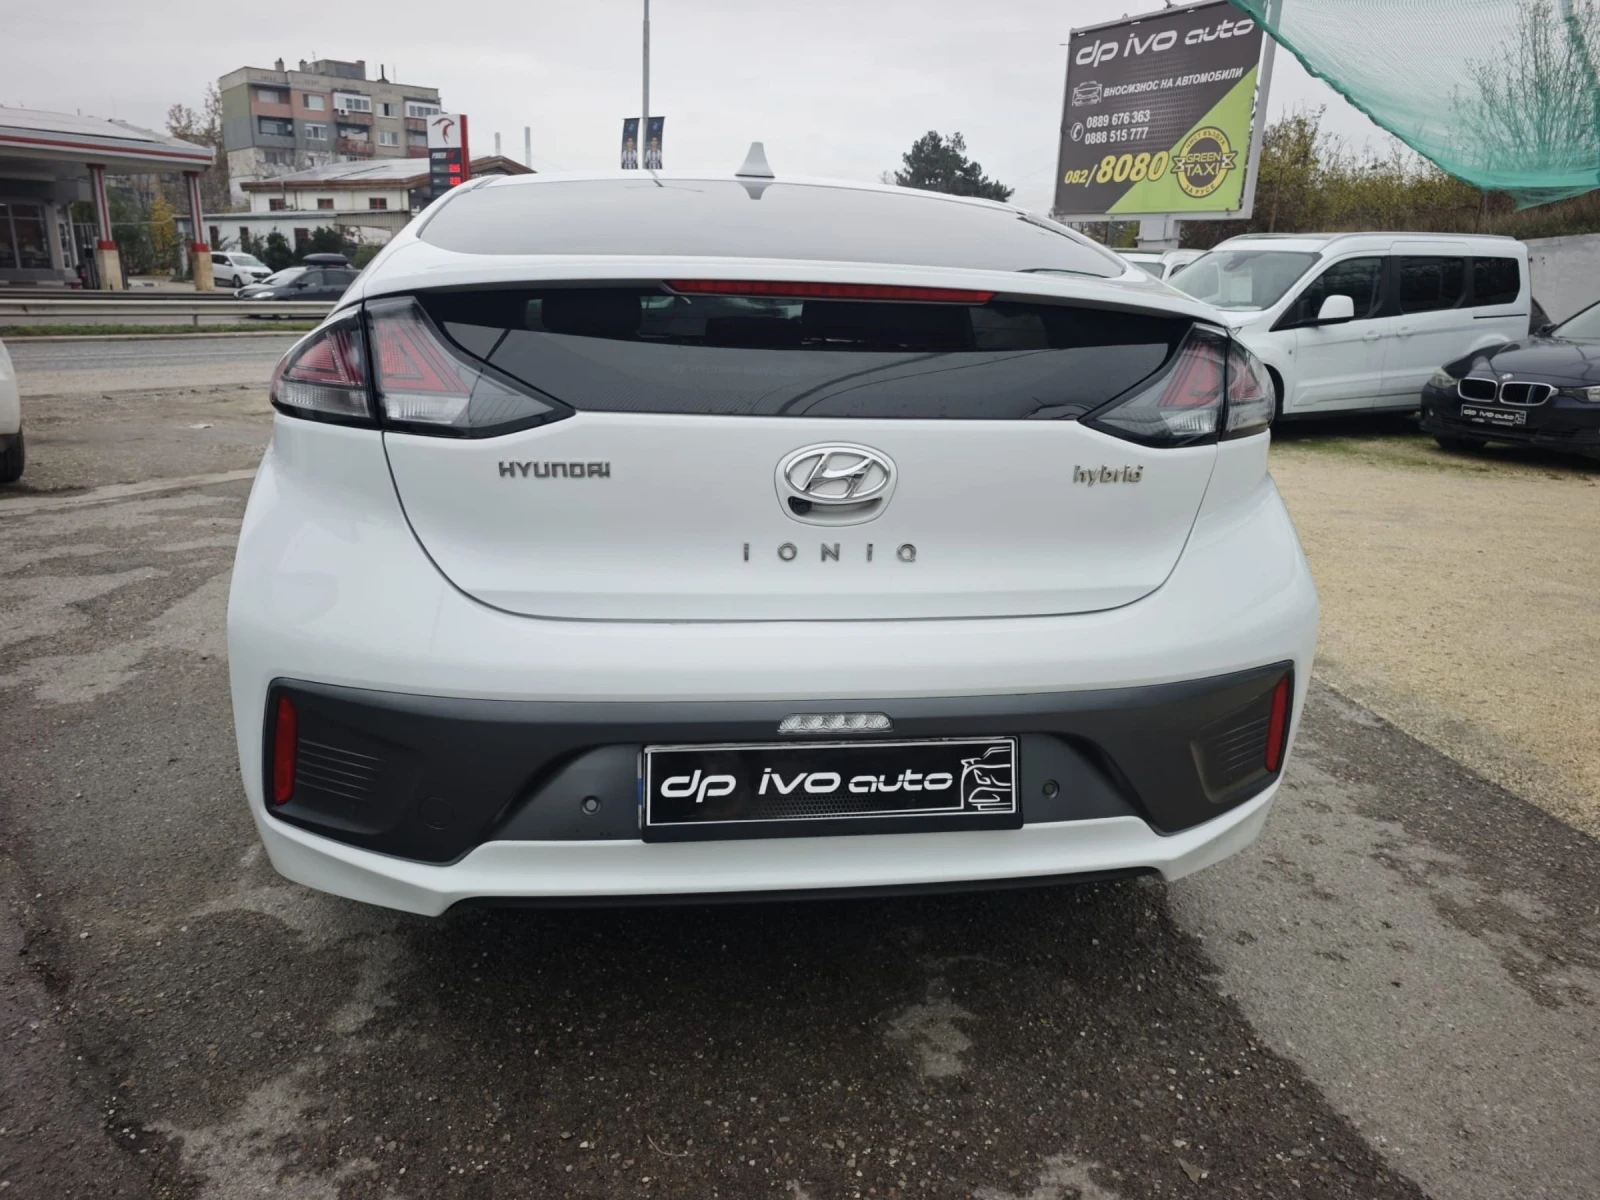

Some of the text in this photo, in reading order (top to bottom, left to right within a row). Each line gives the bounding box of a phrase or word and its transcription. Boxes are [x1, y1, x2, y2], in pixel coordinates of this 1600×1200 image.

[1075, 18, 1255, 67] dp ivo auto
[1103, 66, 1244, 97] ВНОС/ИЗНОС НА АВТОМОБИЛИ
[1086, 109, 1151, 129] 0889 676 363
[1084, 126, 1149, 145] 0888 515 777
[1186, 151, 1222, 163] GREEN
[1185, 162, 1220, 177] TAXI
[498, 460, 611, 479] HYUNDAI
[1073, 464, 1144, 487] hybrid
[743, 542, 917, 563] IONIQ
[660, 767, 954, 803] dp ivo auto
